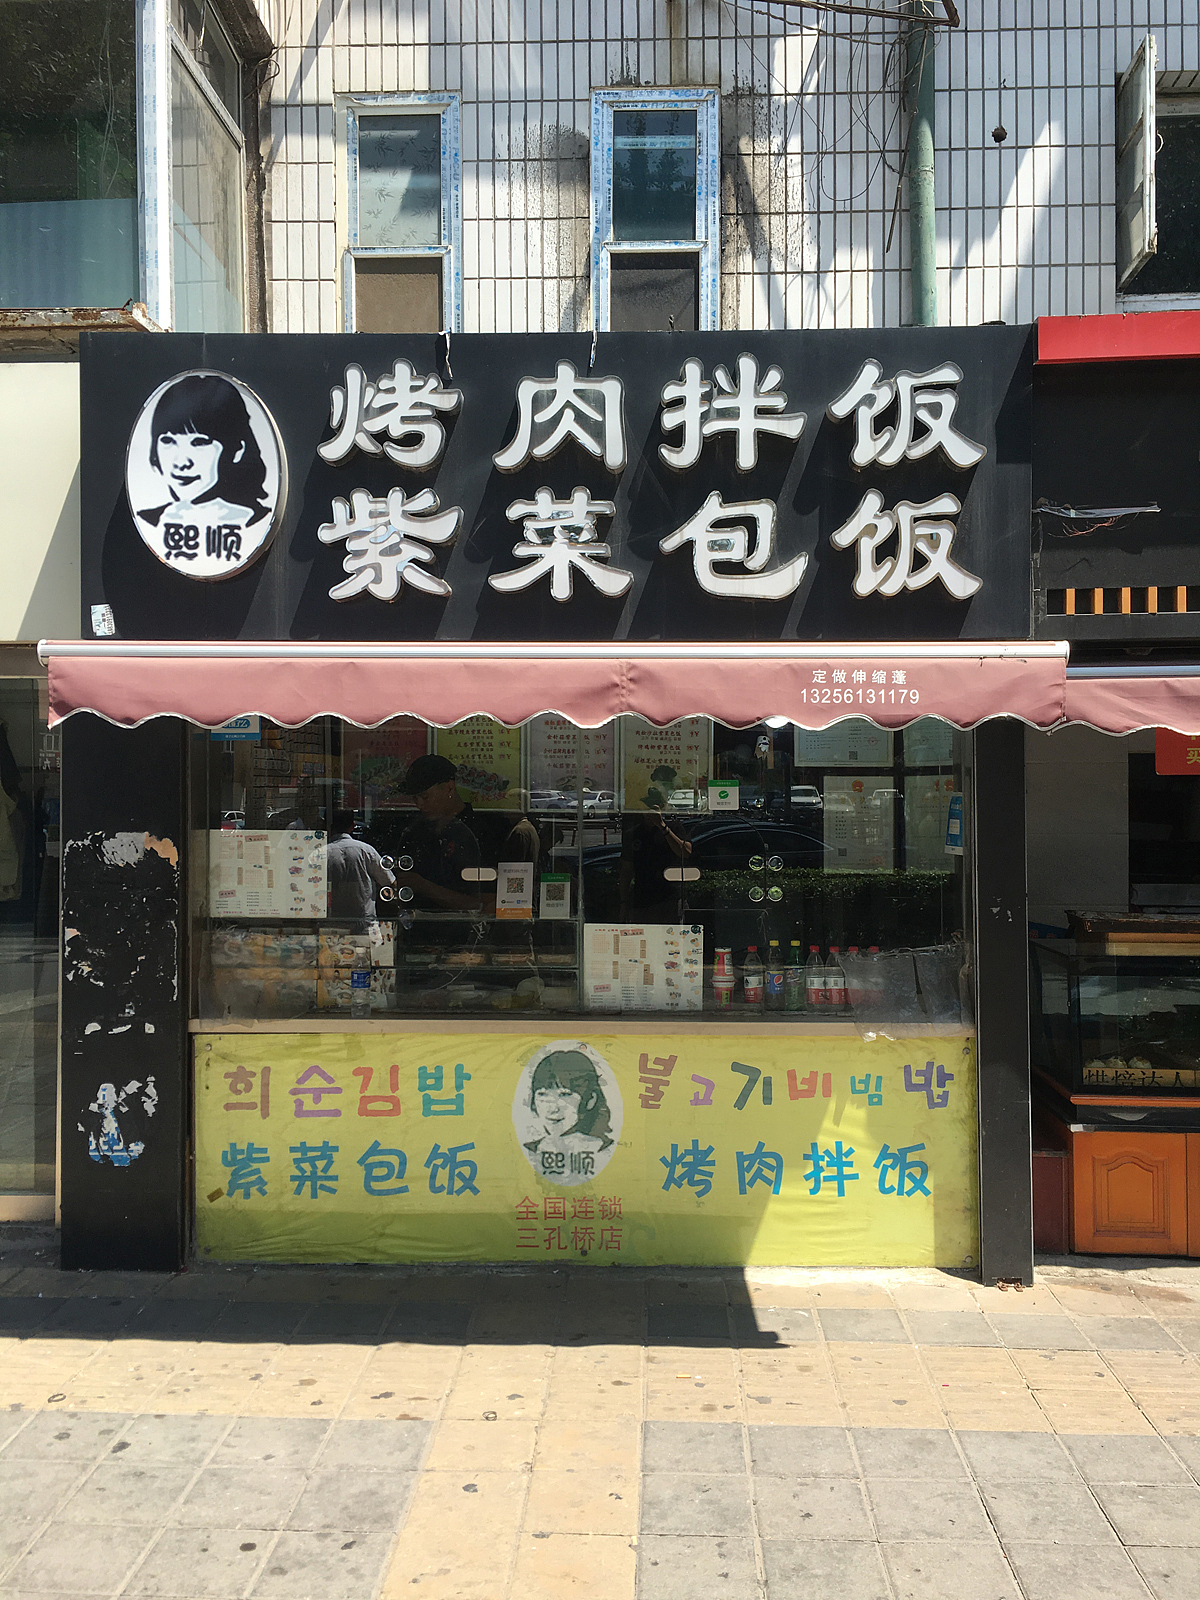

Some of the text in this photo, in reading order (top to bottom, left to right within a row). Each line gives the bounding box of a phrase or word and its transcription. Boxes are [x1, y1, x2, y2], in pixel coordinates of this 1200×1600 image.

[317, 352, 988, 471] 烤肉拌饭
[163, 522, 243, 561] 熙顺
[317, 485, 984, 602] 紫菜包饭
[800, 688, 920, 704] 13256131179
[223, 1063, 472, 1118] 희순김밥
[221, 1139, 481, 1200] 紫菜包饭
[541, 1151, 595, 1175] 熙顺
[658, 1139, 932, 1198] 烤肉拌饭
[515, 1195, 623, 1220] 全国连锁
[515, 1226, 623, 1251] 三孔桥店
